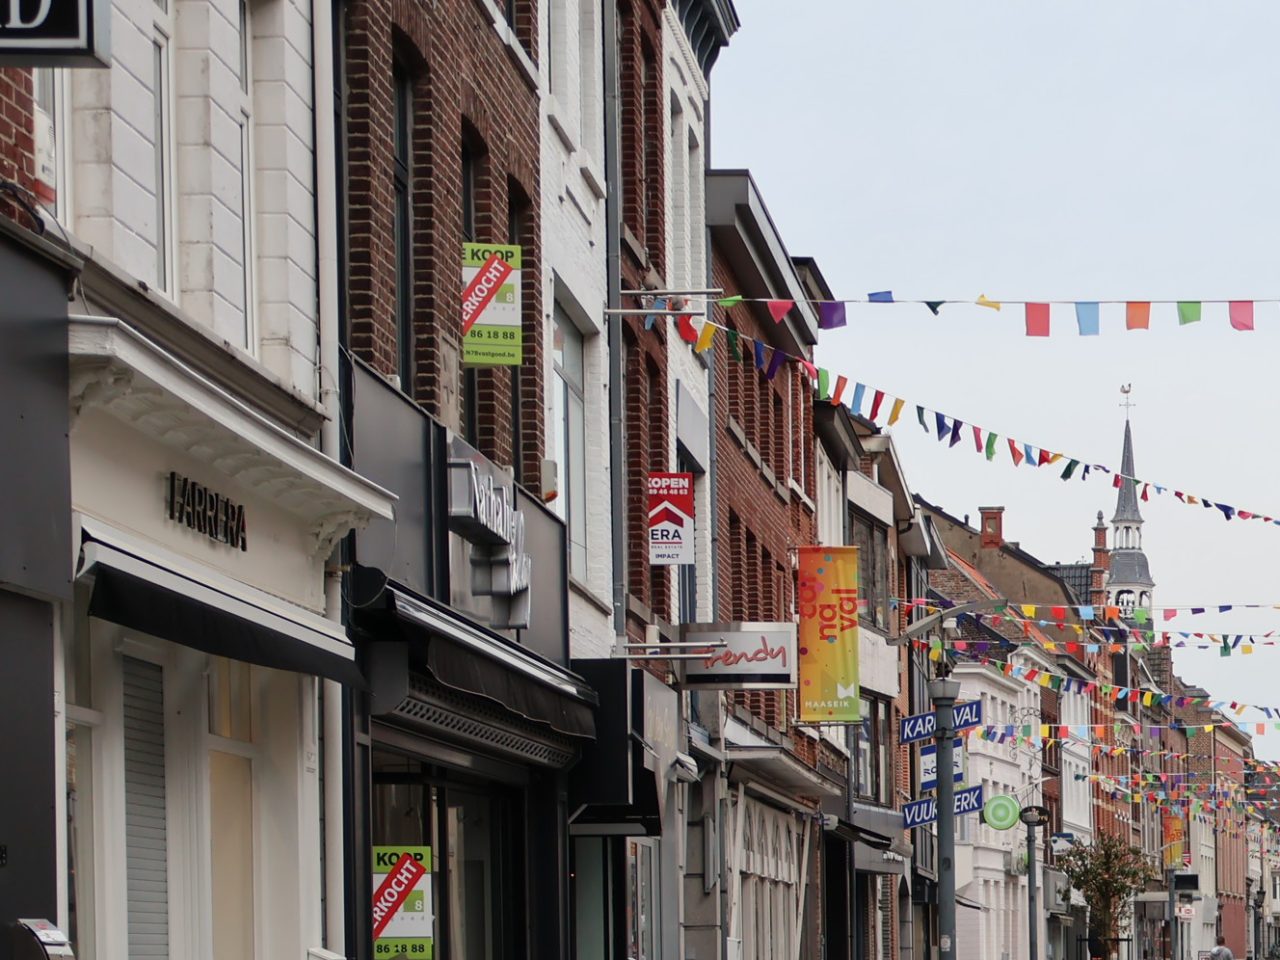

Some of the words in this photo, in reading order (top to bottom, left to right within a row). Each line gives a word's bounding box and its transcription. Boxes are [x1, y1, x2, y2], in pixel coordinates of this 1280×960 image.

[461, 259, 505, 326] ERKOCHT
[650, 528, 682, 541] ERA
[831, 588, 858, 633] val
[804, 700, 850, 709] MAASEIK
[903, 704, 979, 740] KARVAL
[904, 789, 980, 825] VUURERK
[372, 859, 418, 930] RKOCHT
